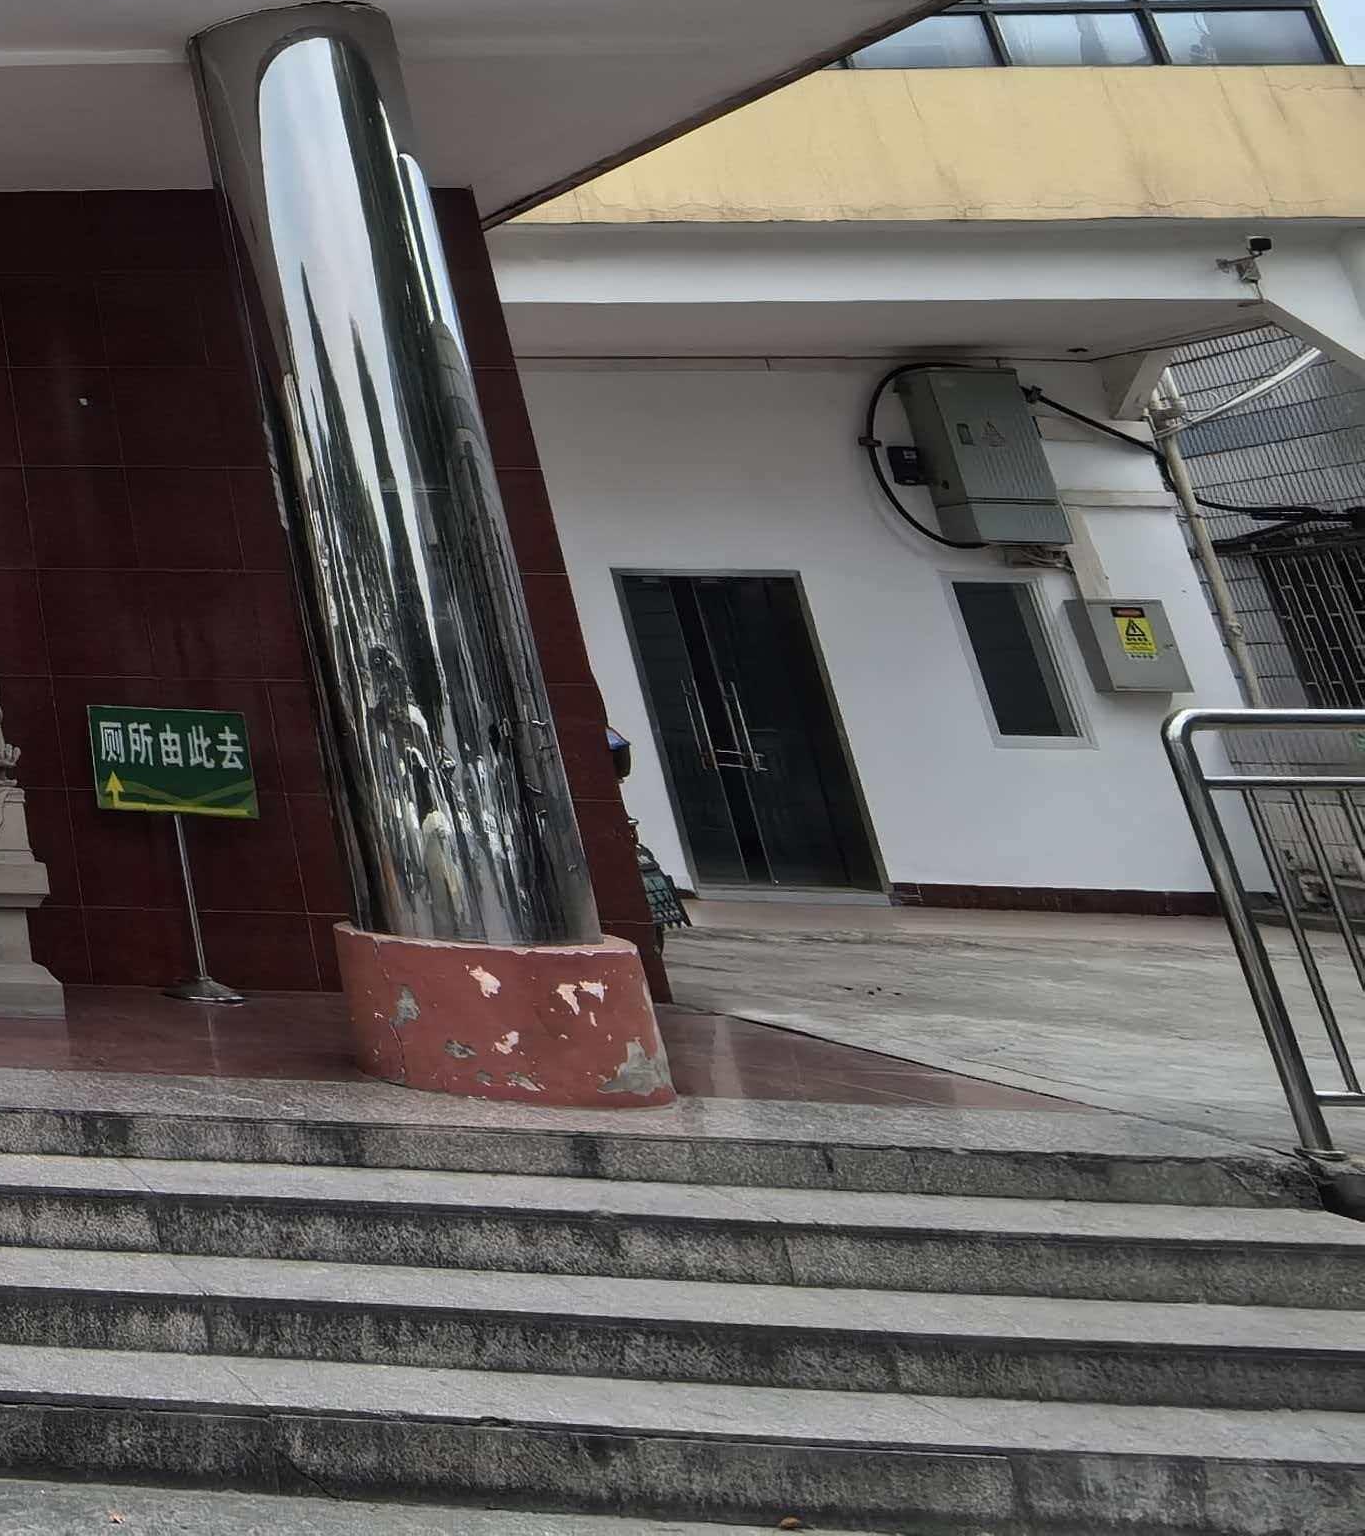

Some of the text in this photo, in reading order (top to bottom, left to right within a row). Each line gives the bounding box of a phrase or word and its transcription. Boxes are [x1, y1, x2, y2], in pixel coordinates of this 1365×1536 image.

[98, 720, 245, 771] 厕所由此去
